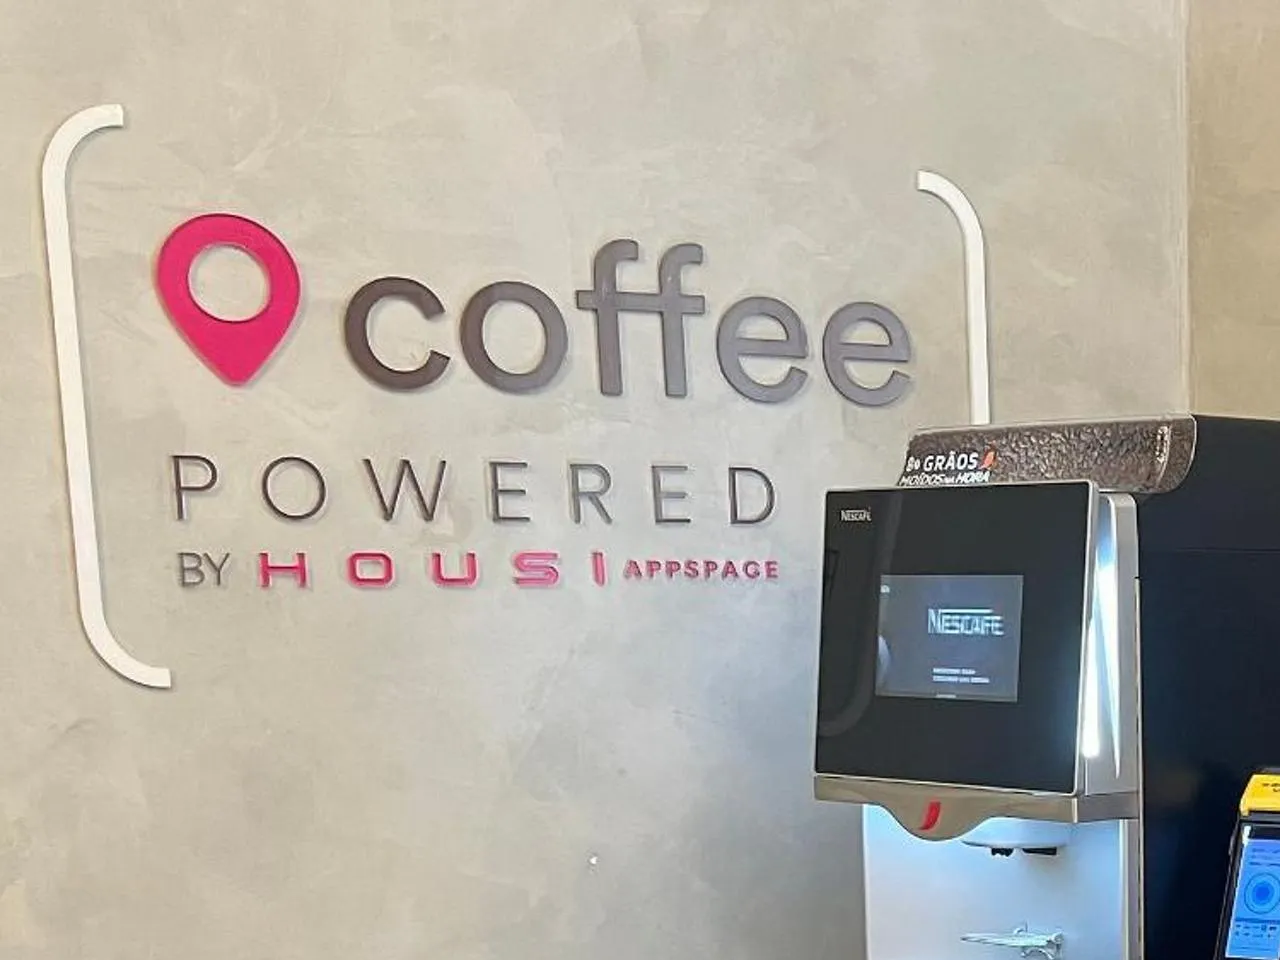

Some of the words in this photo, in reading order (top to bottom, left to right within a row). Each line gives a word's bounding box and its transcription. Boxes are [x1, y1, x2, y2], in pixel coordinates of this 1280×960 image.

[344, 238, 912, 405] coffee
[923, 451, 979, 472] GRÃOS
[172, 454, 776, 526] POWERED
[178, 552, 230, 587] BY
[258, 551, 607, 588] HOUSI
[623, 558, 780, 580] APPSPAGE
